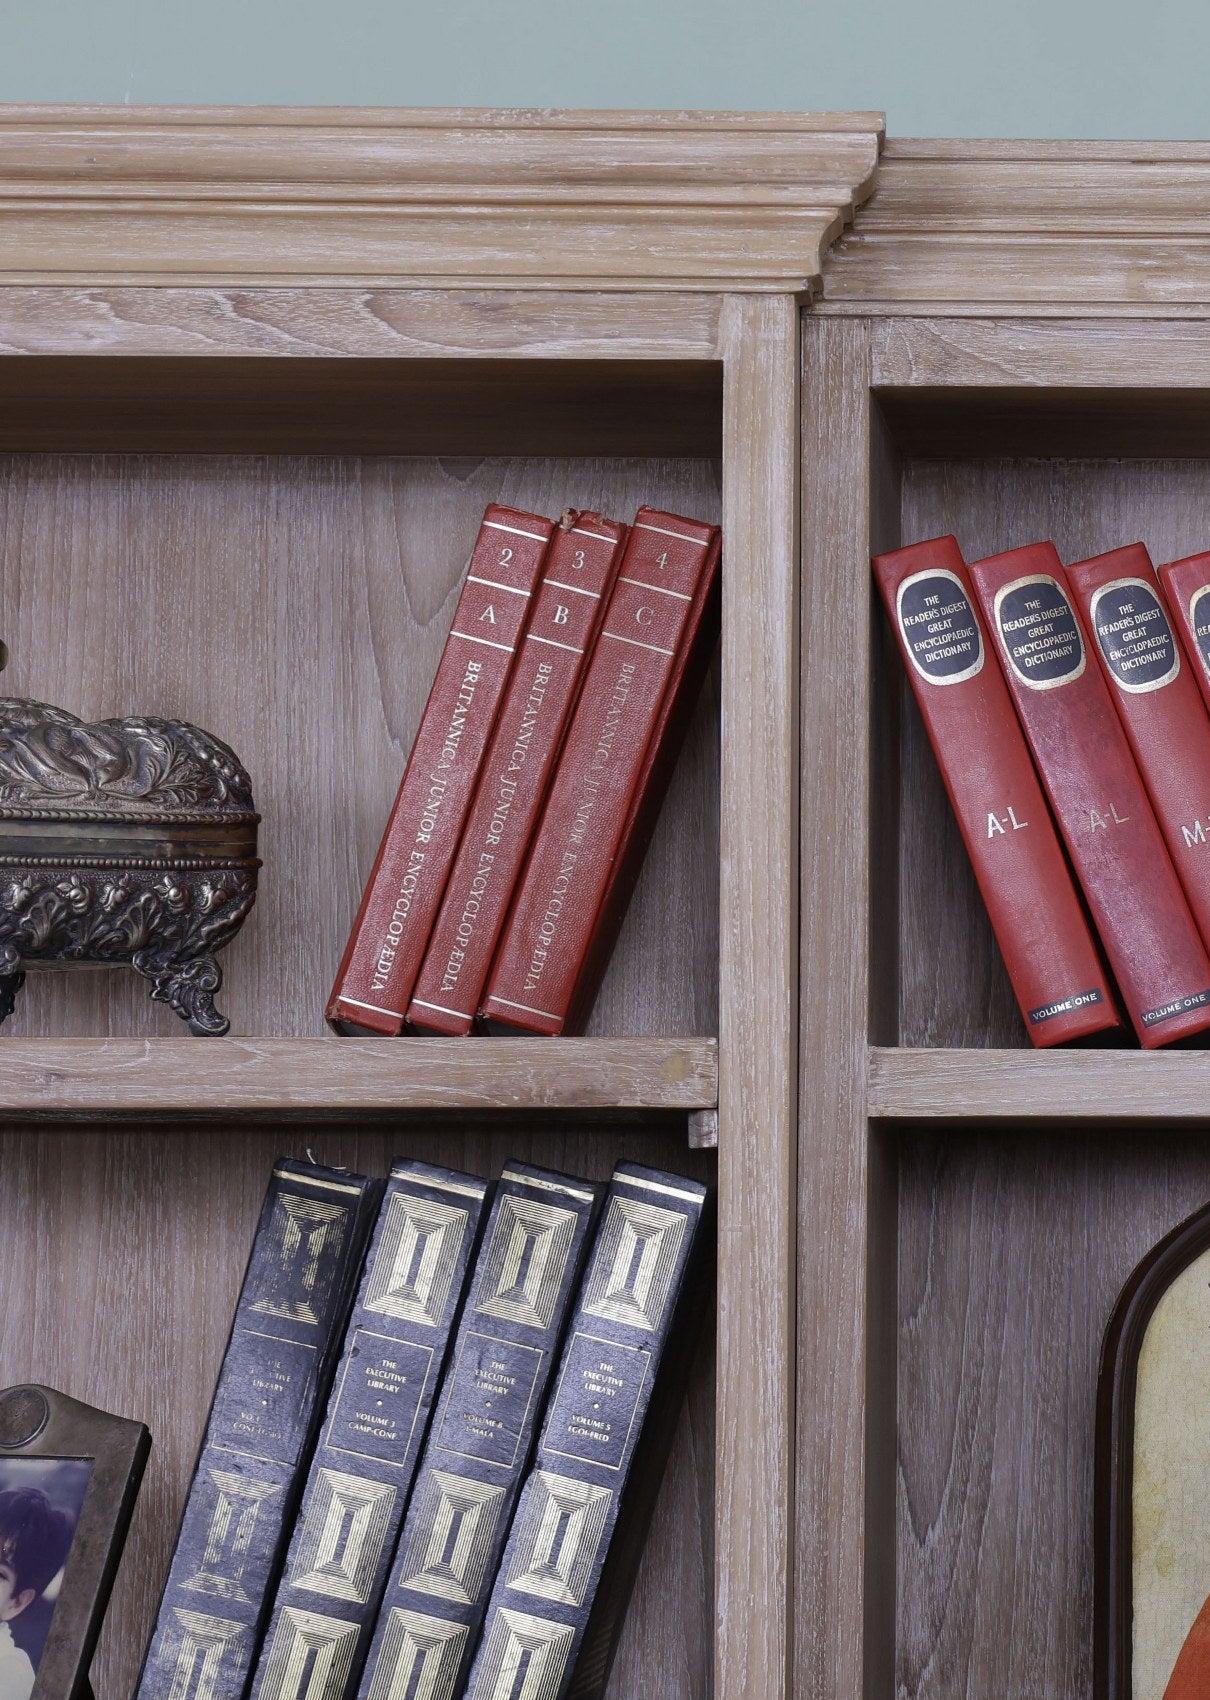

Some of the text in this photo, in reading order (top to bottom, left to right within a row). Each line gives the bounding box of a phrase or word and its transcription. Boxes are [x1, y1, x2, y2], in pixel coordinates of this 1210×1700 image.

[499, 548, 513, 567] 2
[572, 551, 585, 569] 3
[655, 552, 668, 569] 4
[923, 595, 940, 606] THE
[1024, 600, 1042, 611] THE
[1118, 603, 1134, 615] THE
[479, 605, 497, 624] A
[553, 605, 570, 625] B
[636, 606, 654, 625] C
[903, 601, 967, 627] READER'S DIGEST
[1041, 605, 1068, 620] DIGEST
[1135, 608, 1161, 624] DIGEST
[927, 619, 952, 633] GREAT
[1028, 623, 1054, 638] GREAT
[1122, 627, 1147, 642] GREAT
[914, 627, 974, 652] ENCYCLOPAEDIC
[1013, 631, 1077, 657] ENCYCLOPAEDIC
[1110, 634, 1169, 661] ENCYCLOPAEDIC
[925, 642, 972, 663] DICTIONARY
[1025, 646, 1073, 668] DICTIONARY
[1121, 649, 1167, 671] DICTIONARY
[371, 661, 482, 991] BRITANNICA JUNIOR ENCYCLOPÆDIA
[986, 806, 1028, 838] A-L
[1088, 802, 1130, 833] A-L
[441, 662, 552, 992] BRITANNICA JUNIOR ENCYCLOPÆDIA
[523, 664, 635, 991] BRITANNICA JUNIOR ENCYCLOPÆDIA
[1032, 993, 1097, 1020] VOLUME ONE
[1142, 994, 1206, 1022] VOLUME ONE
[382, 1359, 397, 1369] THE
[491, 1361, 505, 1371] THE
[600, 1362, 614, 1372] THE
[366, 1367, 407, 1383] EXECUTIVE
[475, 1368, 516, 1385] EXECUTIVE
[583, 1370, 623, 1387] EXECUTIVE
[367, 1380, 400, 1394] LIBRARY
[477, 1381, 509, 1395] LIBRARY
[584, 1383, 617, 1397] LIBRARY
[355, 1412, 388, 1426] VOLUME
[463, 1412, 497, 1427] VOLUME
[572, 1415, 605, 1429] VOLUME
